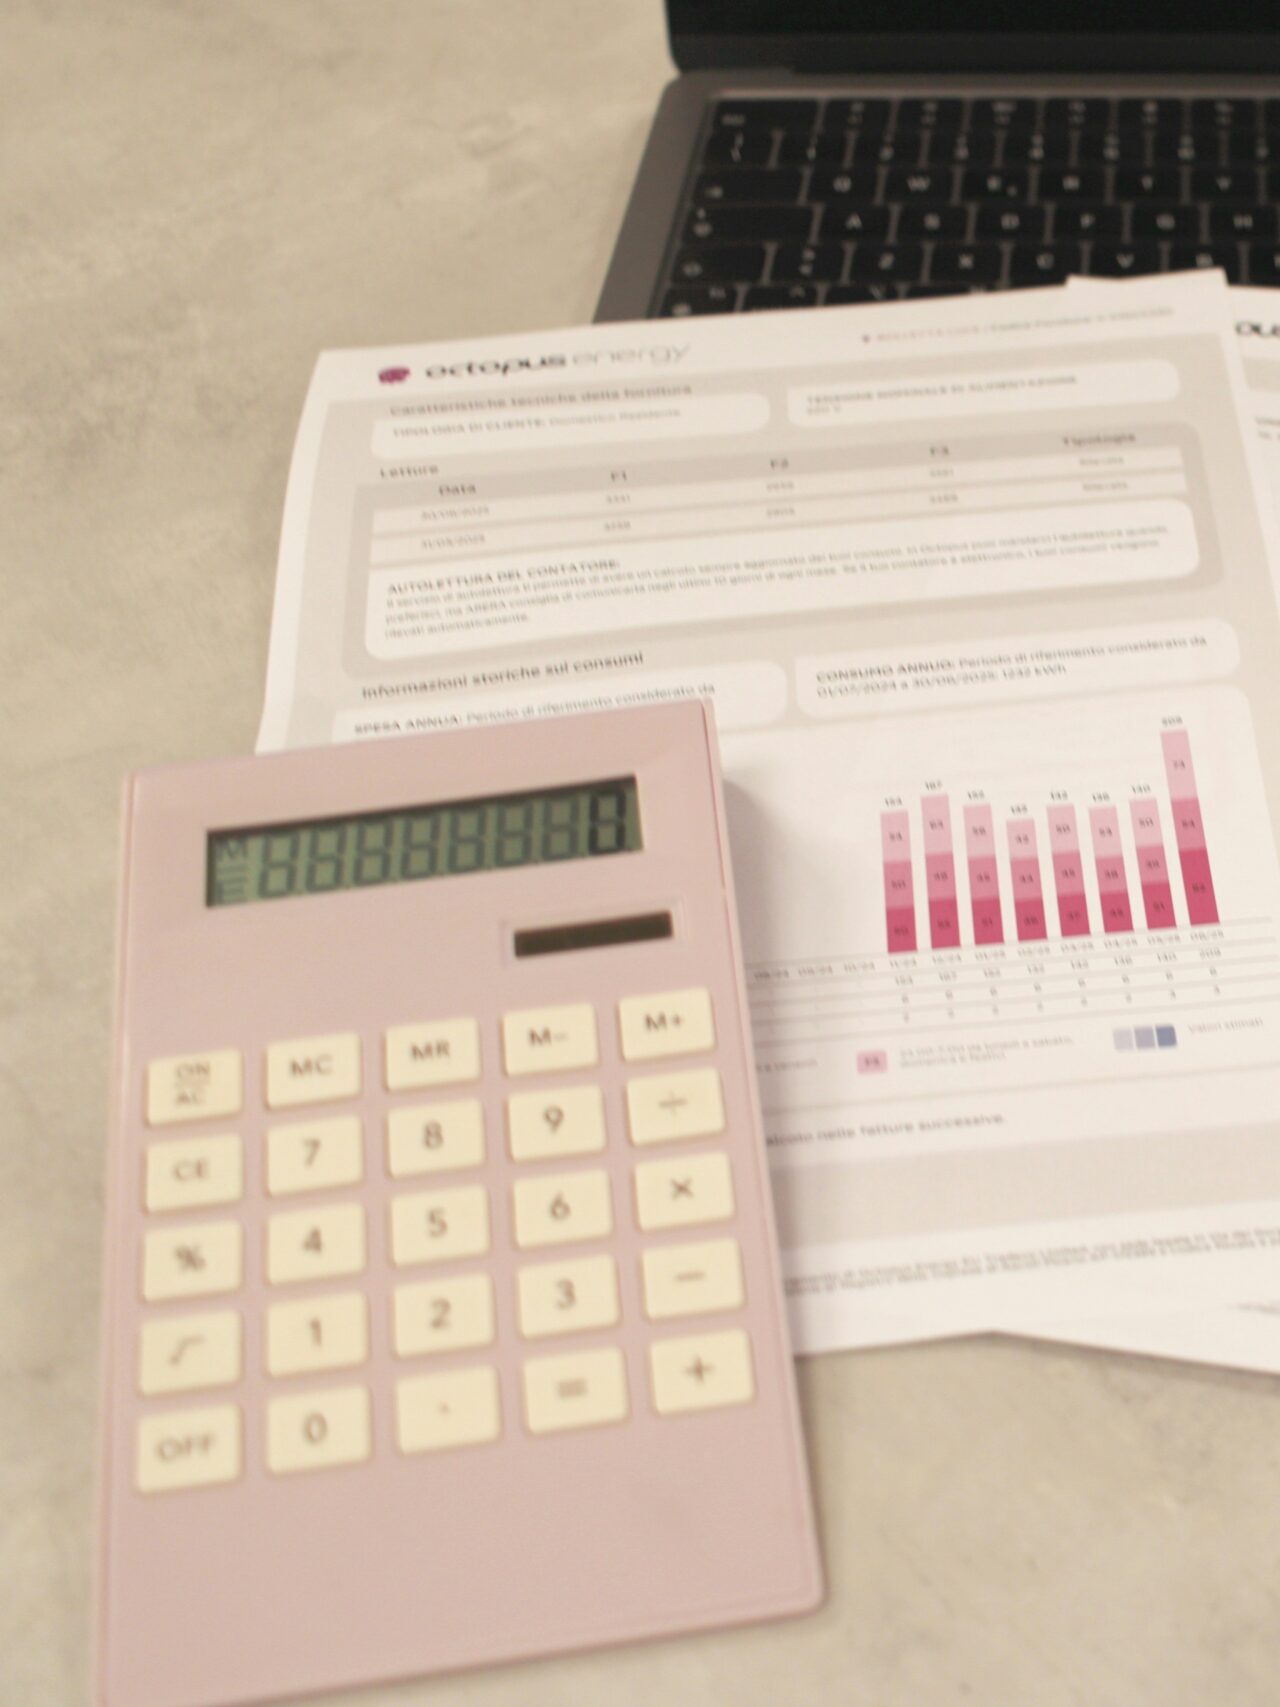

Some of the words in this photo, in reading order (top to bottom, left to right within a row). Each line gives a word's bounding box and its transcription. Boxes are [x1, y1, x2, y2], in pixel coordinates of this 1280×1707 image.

[424, 353, 566, 380] octopus
[572, 345, 691, 368] energy
[439, 482, 477, 496] Data
[362, 674, 468, 699] Informazioni
[472, 666, 541, 686] storiche
[545, 660, 569, 676] sui
[573, 651, 645, 673] consumi
[816, 665, 894, 684] CONSUMO
[959, 654, 1012, 669] Periodo
[1014, 652, 1028, 664] di
[1107, 639, 1187, 656] considerato
[1190, 635, 1207, 648] da
[175, 1061, 211, 1082] ON
[290, 1054, 334, 1078] MC
[411, 1039, 451, 1062] MR
[645, 1010, 685, 1033] M+
[174, 1158, 209, 1183] CE
[301, 1140, 321, 1167] 7
[423, 1122, 444, 1151] 8
[543, 1105, 564, 1135] 9
[174, 1245, 205, 1272] %
[302, 1229, 322, 1257] 4
[426, 1210, 448, 1239] 5
[549, 1195, 571, 1221] 6
[308, 1319, 322, 1346] 1
[428, 1299, 451, 1328] 2
[556, 1280, 577, 1309] 3
[155, 1434, 216, 1464] OFF
[303, 1413, 327, 1443] 0
